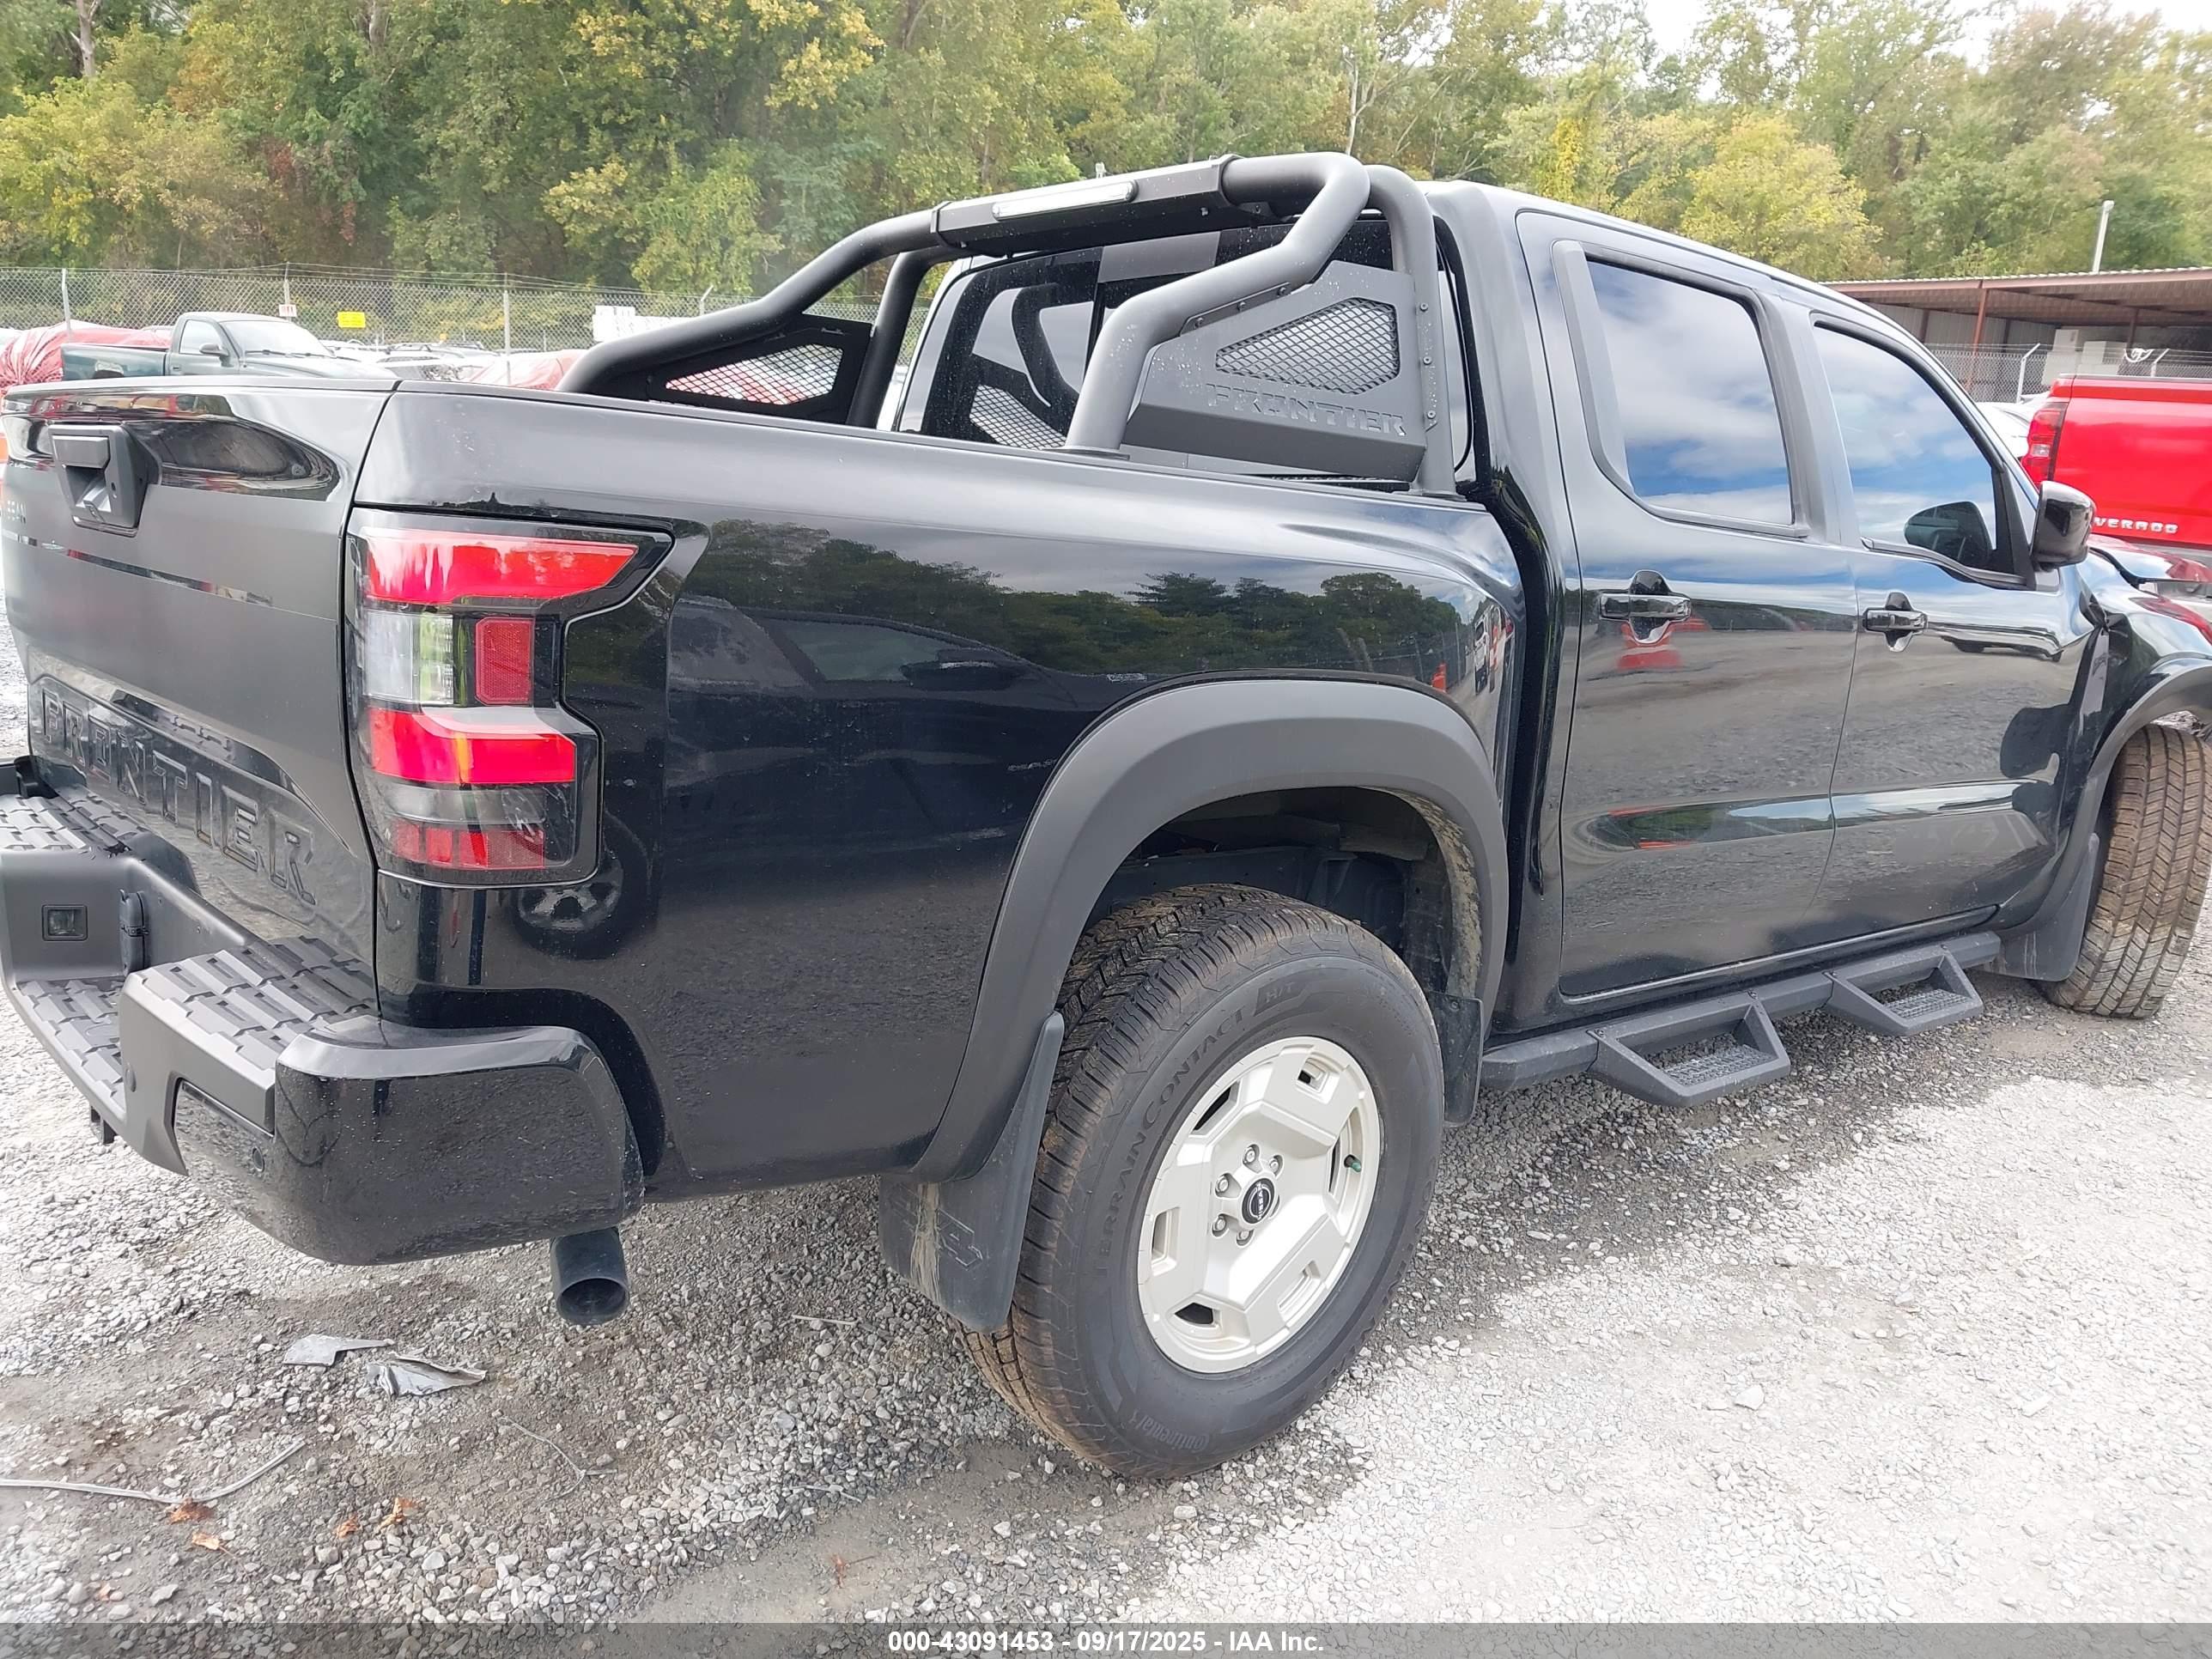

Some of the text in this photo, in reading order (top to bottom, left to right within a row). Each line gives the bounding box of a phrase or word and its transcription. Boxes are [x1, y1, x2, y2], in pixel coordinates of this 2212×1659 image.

[1206, 383, 1407, 436] FRONTIER
[2094, 517, 2179, 534] VERADO
[42, 689, 316, 905] FRONTIER
